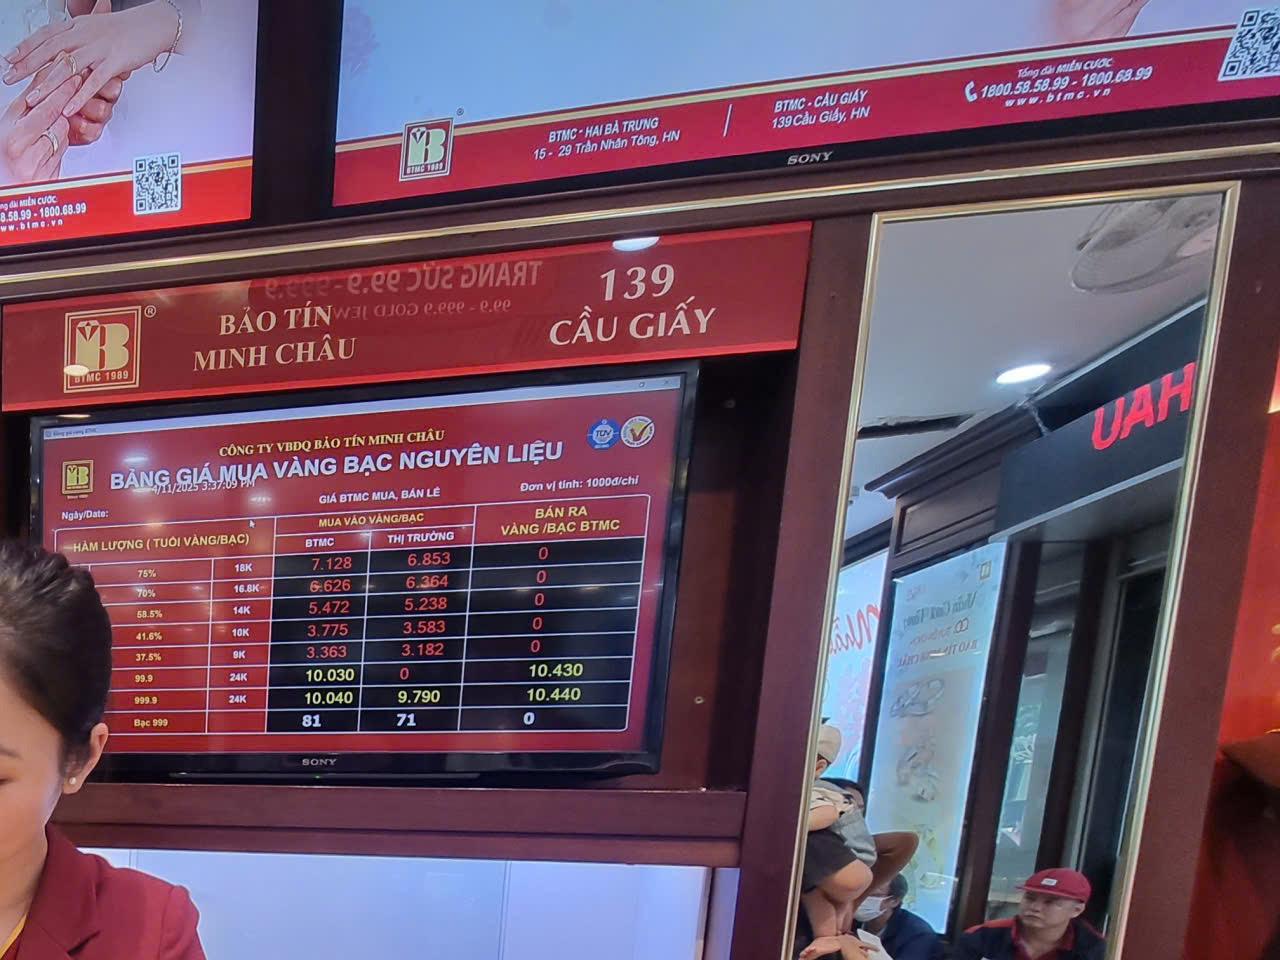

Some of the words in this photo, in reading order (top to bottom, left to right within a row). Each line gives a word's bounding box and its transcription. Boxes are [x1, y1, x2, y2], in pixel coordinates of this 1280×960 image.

[981, 76, 1069, 98] 1800.58.58.99
[1082, 66, 1152, 87] 1800.68.99
[774, 98, 806, 113] BTMC
[850, 105, 870, 119] HN
[549, 128, 576, 142] BTMC
[585, 125, 603, 138] HAI
[533, 148, 546, 160] 15
[558, 144, 572, 156] 29
[662, 130, 680, 142] HN
[788, 151, 832, 165] SONY
[40, 204, 86, 218] 1800.68.99
[600, 264, 674, 301] 139
[220, 308, 276, 336] BẢO
[285, 301, 332, 330] TÍN
[550, 306, 617, 345] CẦU
[630, 296, 716, 339] GIẤY
[194, 345, 267, 370] MINH
[276, 334, 356, 364] CHÂU
[106, 370, 129, 381] 1989
[220, 443, 254, 456] CÔNG
[258, 443, 272, 454] TY
[369, 434, 403, 445] MINH
[407, 428, 444, 442] CHÂU
[110, 470, 170, 490] BẢNG
[176, 463, 213, 485] GIÁ
[220, 464, 267, 482] MUA
[274, 457, 337, 478] VÀNG
[344, 452, 392, 475] BẠC
[400, 443, 499, 470] NGUYÊN
[508, 440, 563, 464] LIỆU
[241, 479, 255, 488] PM
[62, 509, 108, 520] Ngày/Date:
[535, 507, 564, 519] BÁN
[568, 506, 588, 516] RA
[501, 524, 538, 536] VÀNG
[581, 520, 620, 531] BTMC
[306, 538, 334, 548] BTMC
[234, 564, 252, 572] 18K
[312, 558, 352, 570] 7.128
[408, 552, 451, 566] 6.853
[310, 580, 351, 592] 6.626
[406, 576, 448, 588] 6.364
[137, 609, 162, 618] 58.5%
[308, 601, 350, 614] 5.472
[404, 597, 448, 611] 5.238
[308, 624, 348, 637] 3.775
[403, 620, 446, 634] 3.583
[306, 646, 347, 658] 3.363
[402, 643, 444, 656] 3.182
[229, 674, 248, 682] 24K
[306, 669, 354, 682] 10.030
[529, 663, 584, 678] 10.430
[134, 696, 158, 704] 999.9
[304, 692, 353, 704] 10.040
[398, 690, 440, 704] 9.790
[527, 688, 581, 701] 10.440
[302, 715, 321, 727] 81
[397, 714, 416, 726] 71
[302, 758, 337, 766] SONY
